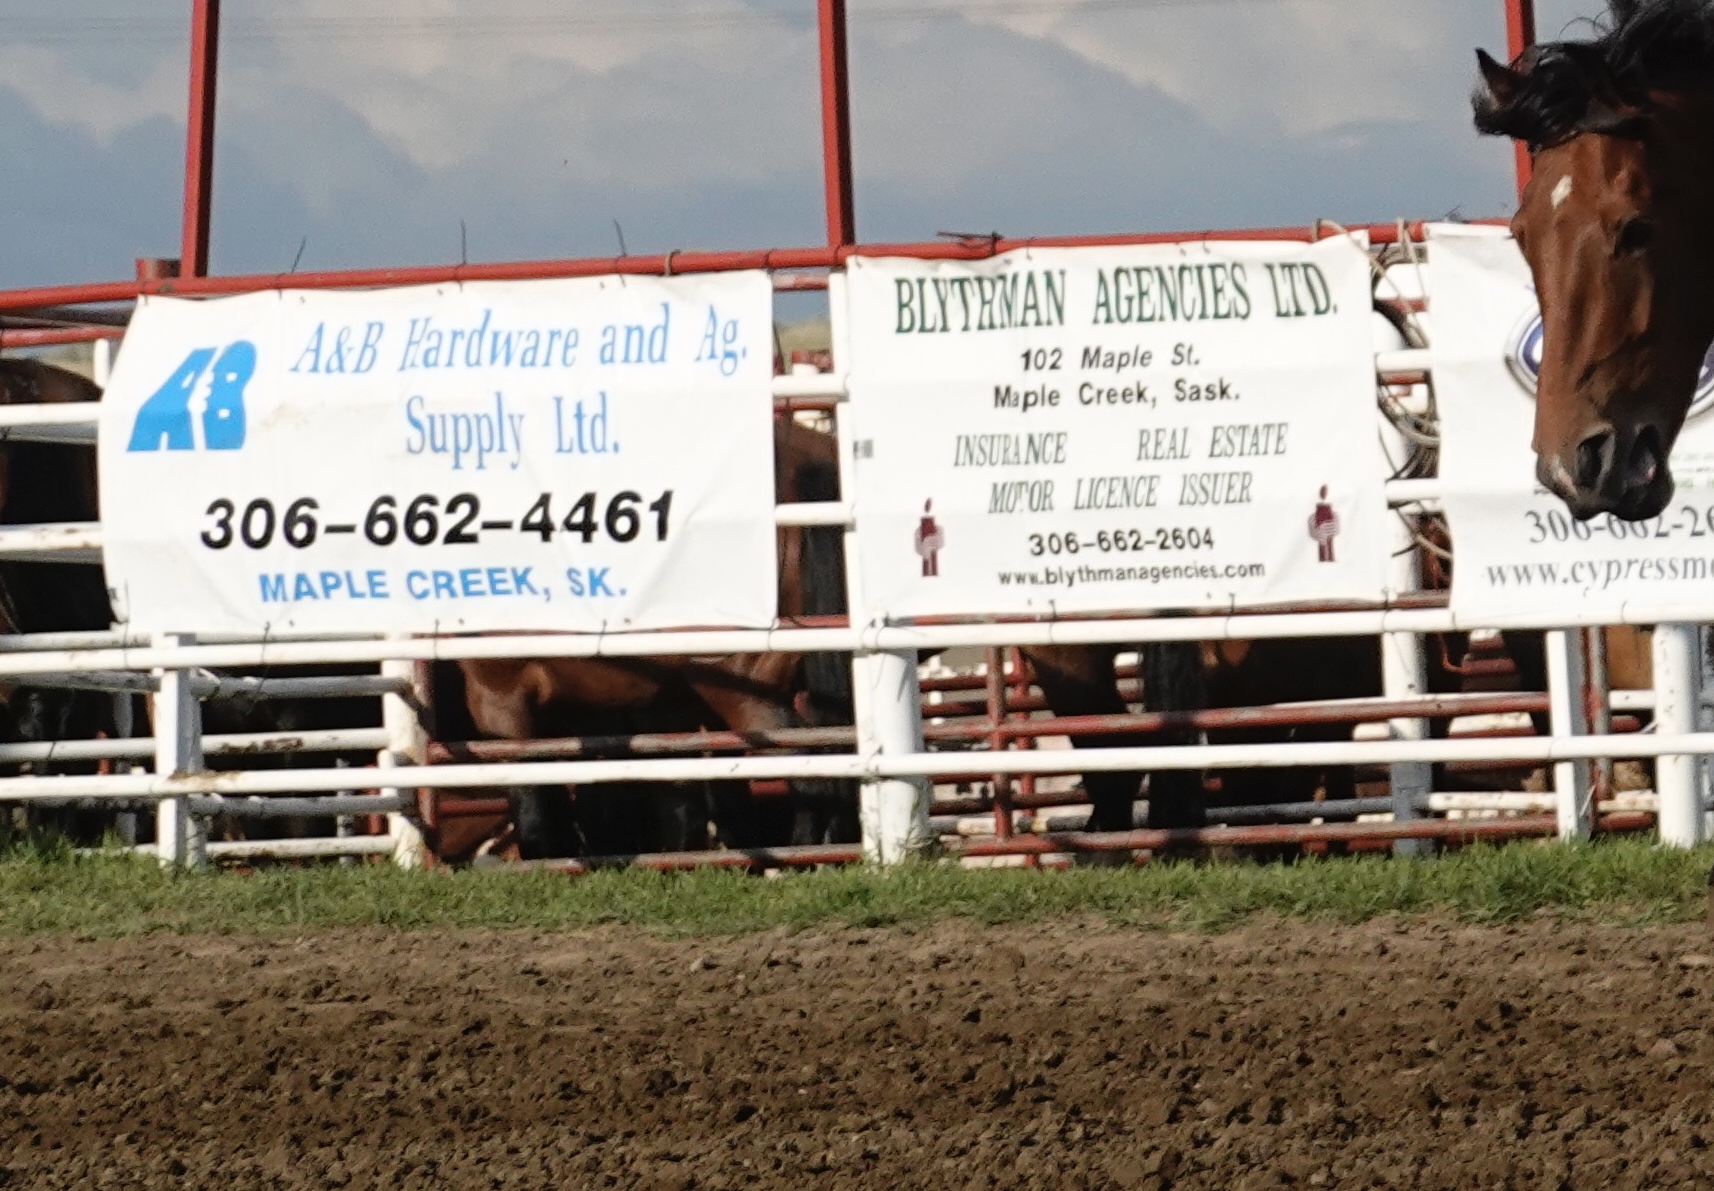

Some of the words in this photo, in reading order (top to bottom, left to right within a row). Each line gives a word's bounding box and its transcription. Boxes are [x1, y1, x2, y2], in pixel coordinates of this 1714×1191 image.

[1092, 262, 1252, 324] AGENCIES
[1264, 261, 1338, 317] LTD.
[289, 322, 385, 373] A&B
[398, 309, 580, 372] Hardware
[599, 303, 671, 365] and
[694, 304, 749, 376] Ag.
[1020, 347, 1062, 372] 102
[1080, 346, 1153, 373] Maple
[1170, 343, 1200, 367] St.
[993, 385, 1062, 413] Maple
[1079, 378, 1157, 409] Creek,
[1175, 377, 1240, 403] Sask.
[405, 397, 525, 471] Supply
[554, 392, 621, 455] Ltd.
[953, 431, 1069, 468] INSURANCE
[1136, 426, 1191, 462] REAL
[1208, 422, 1290, 459] ESTATE
[988, 480, 1056, 515] MOTOR
[1074, 474, 1162, 511] LICENCE
[1178, 471, 1254, 507] ISSUER
[200, 489, 674, 551] 306-662-4461
[1028, 526, 1216, 557] 306-662-2604
[258, 571, 391, 603] MAPLE
[406, 566, 552, 603] CREEK,
[566, 566, 628, 598] SK.
[998, 559, 1267, 587] www.blythmanagencies.com
